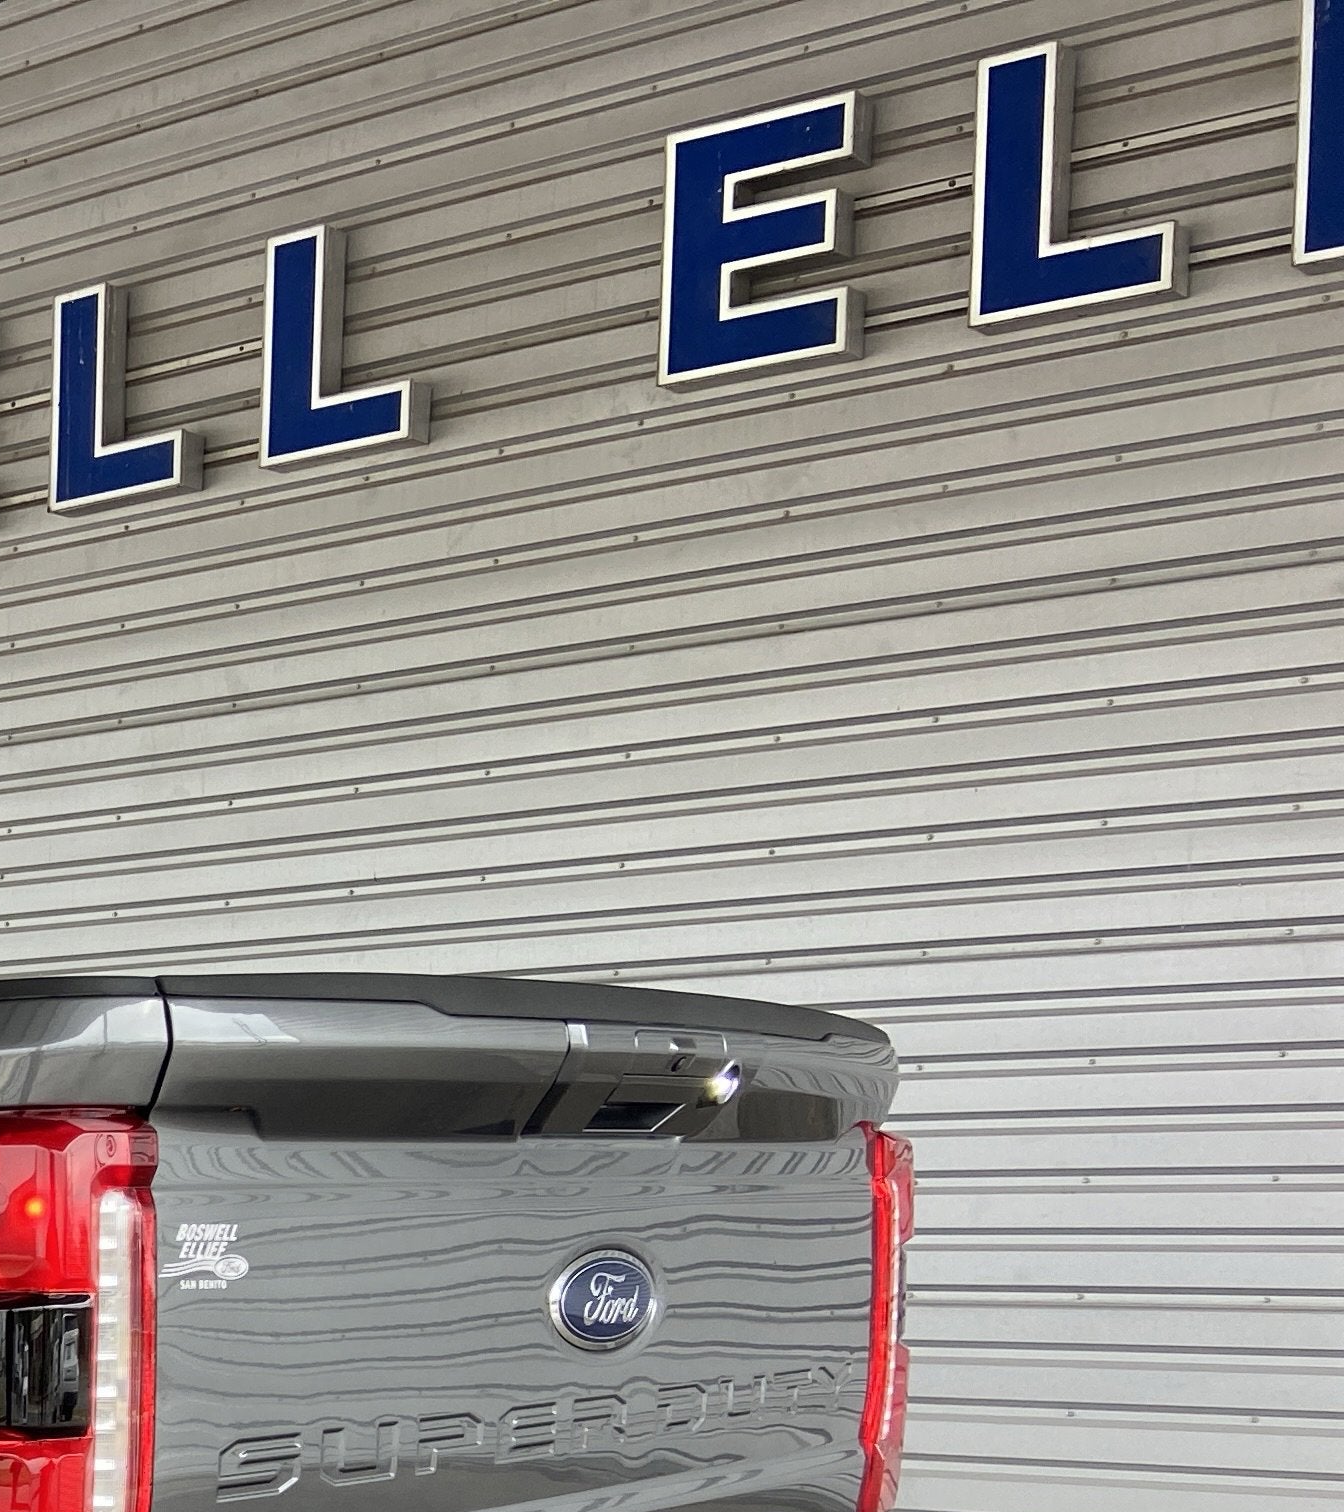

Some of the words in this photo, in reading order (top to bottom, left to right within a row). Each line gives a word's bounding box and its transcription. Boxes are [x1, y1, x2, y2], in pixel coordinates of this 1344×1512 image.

[656, 0, 1344, 388] EL
[175, 1224, 238, 1241] BOSWELL
[180, 1280, 197, 1290] SAN
[198, 1280, 228, 1290] BENITO
[583, 1272, 640, 1326] Ford
[216, 1394, 628, 1503] SUPER
